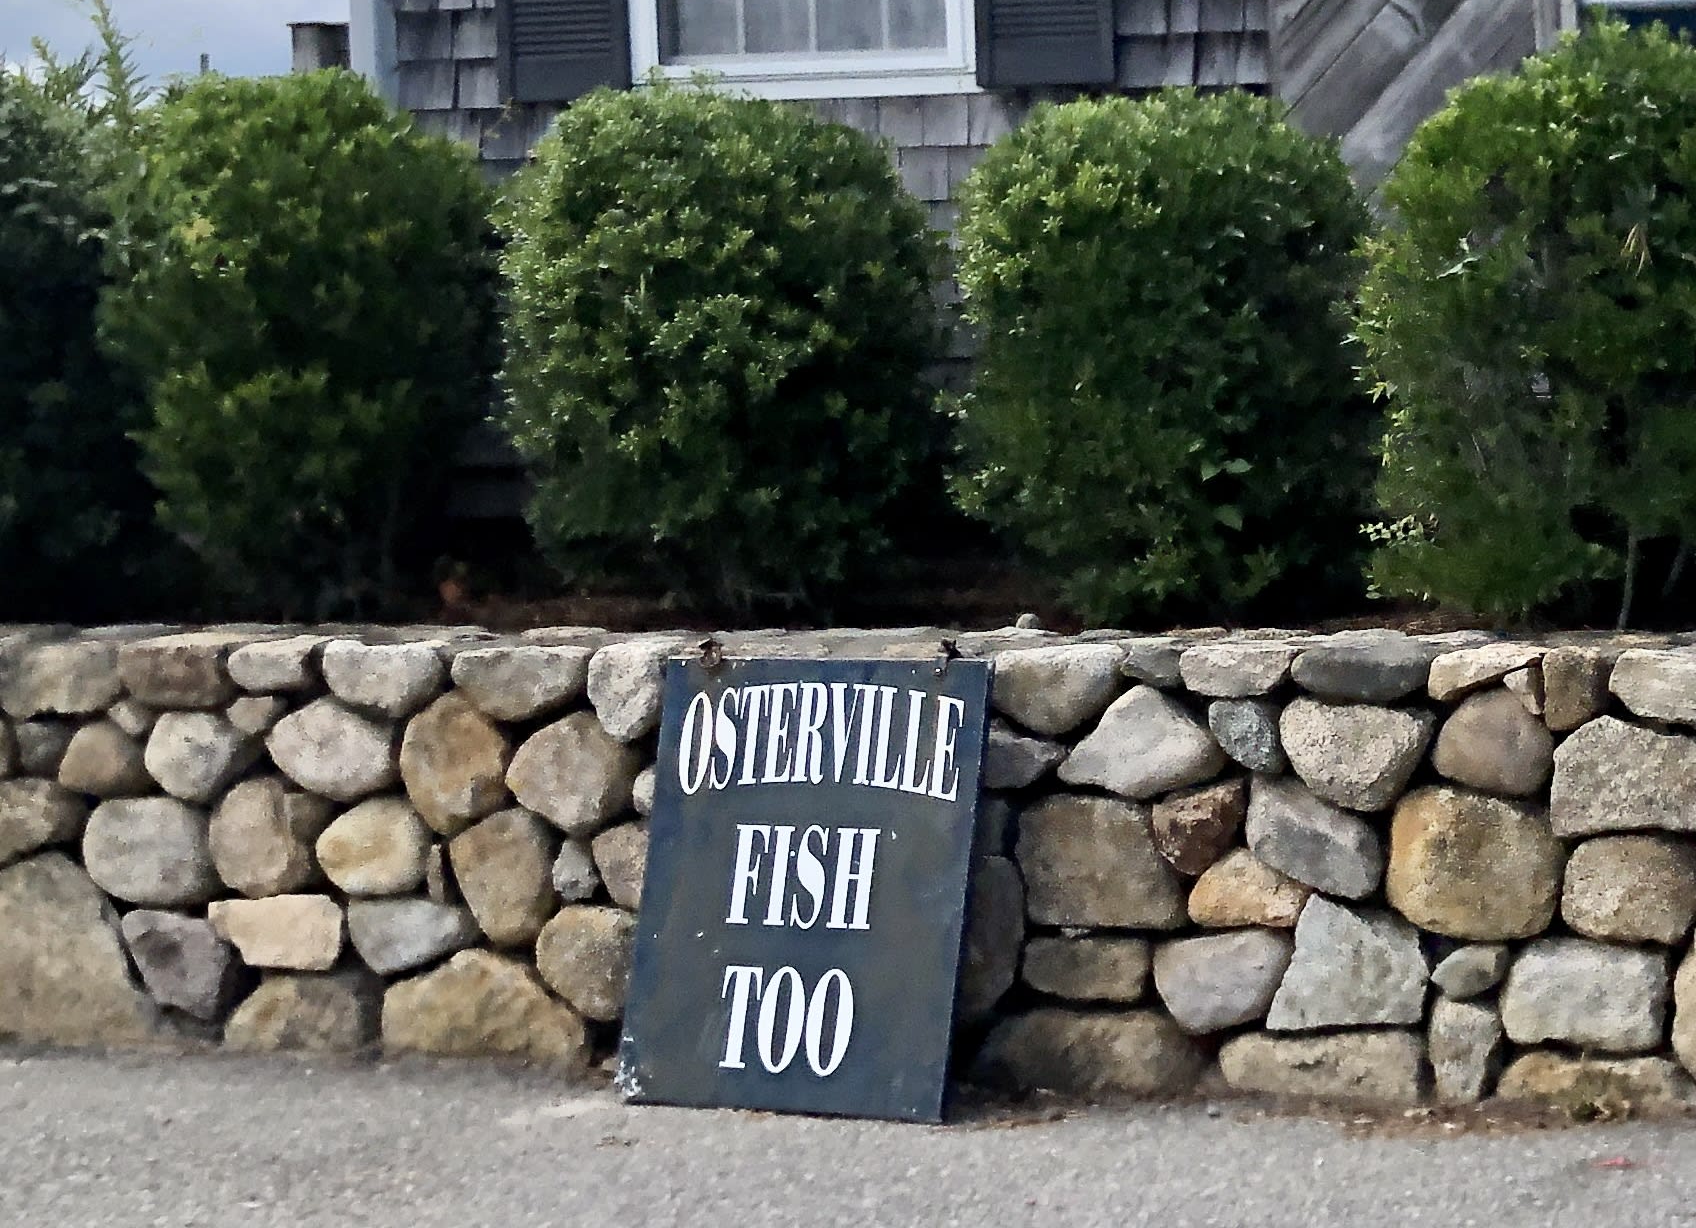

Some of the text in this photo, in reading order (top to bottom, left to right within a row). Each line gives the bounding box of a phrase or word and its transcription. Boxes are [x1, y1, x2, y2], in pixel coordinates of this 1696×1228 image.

[678, 681, 965, 802] OSTERVILLE
[725, 823, 880, 930] FISH
[718, 965, 854, 1077] TOO
